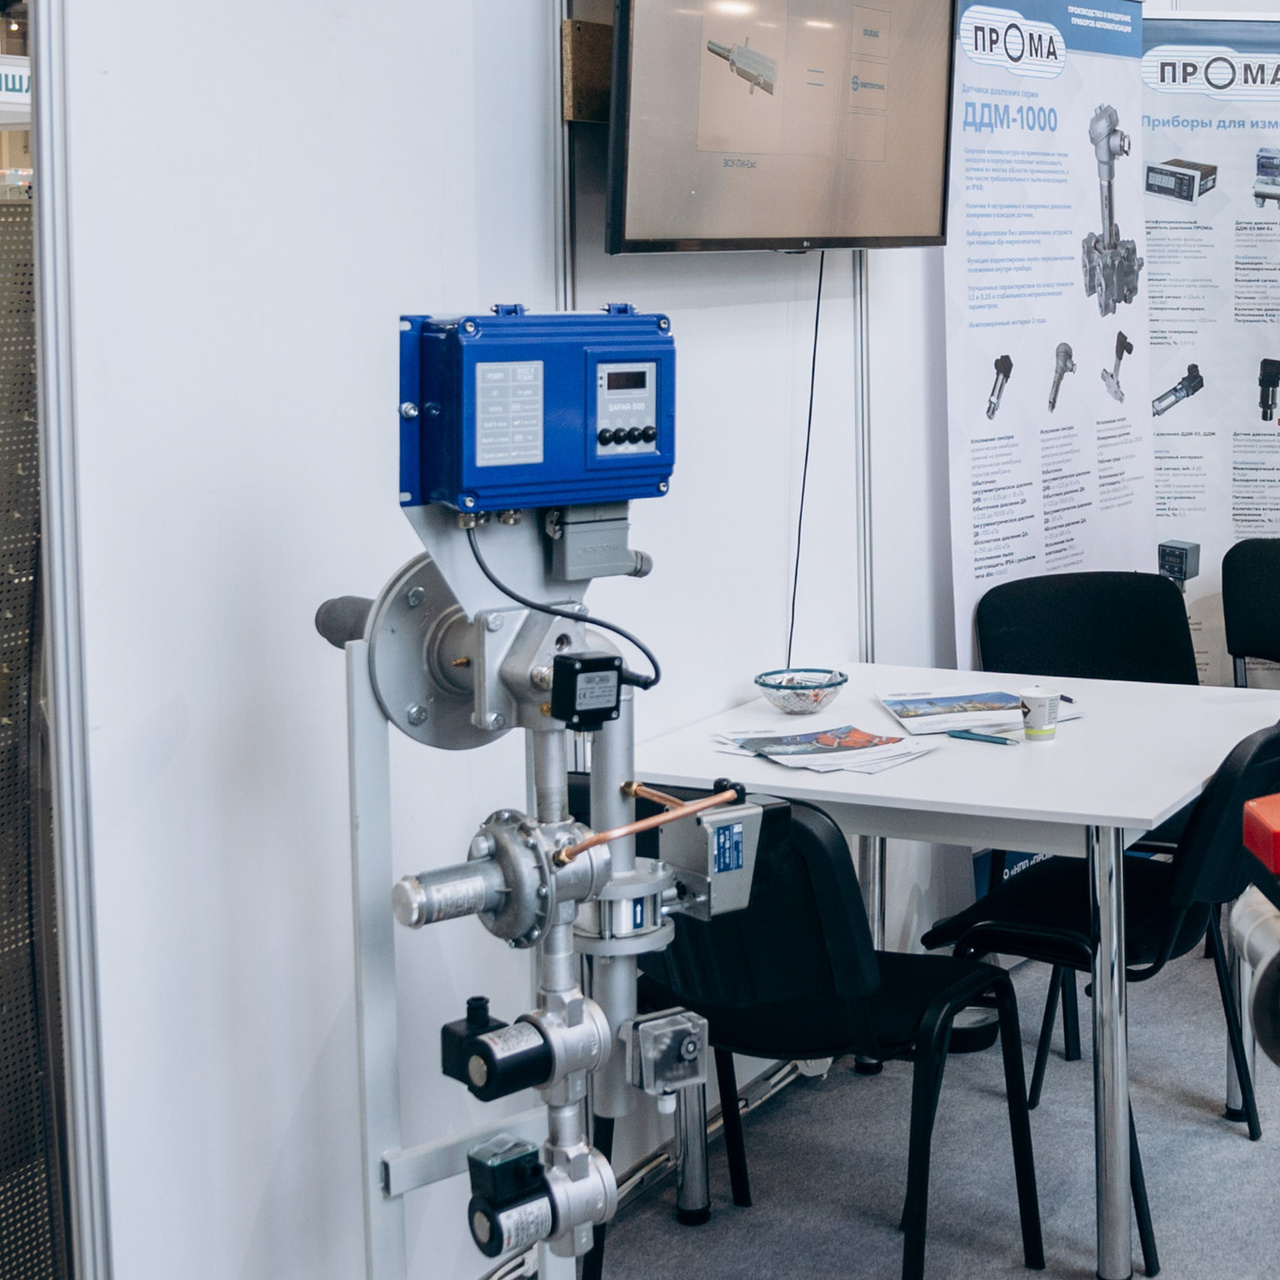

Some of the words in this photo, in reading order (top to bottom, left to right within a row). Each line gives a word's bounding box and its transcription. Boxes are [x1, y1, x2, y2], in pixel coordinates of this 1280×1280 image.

[973, 22, 1059, 64] ПРОМА
[963, 101, 1058, 134] ДДМ-1000
[1142, 115, 1213, 131] Приборы
[1216, 117, 1246, 131] для
